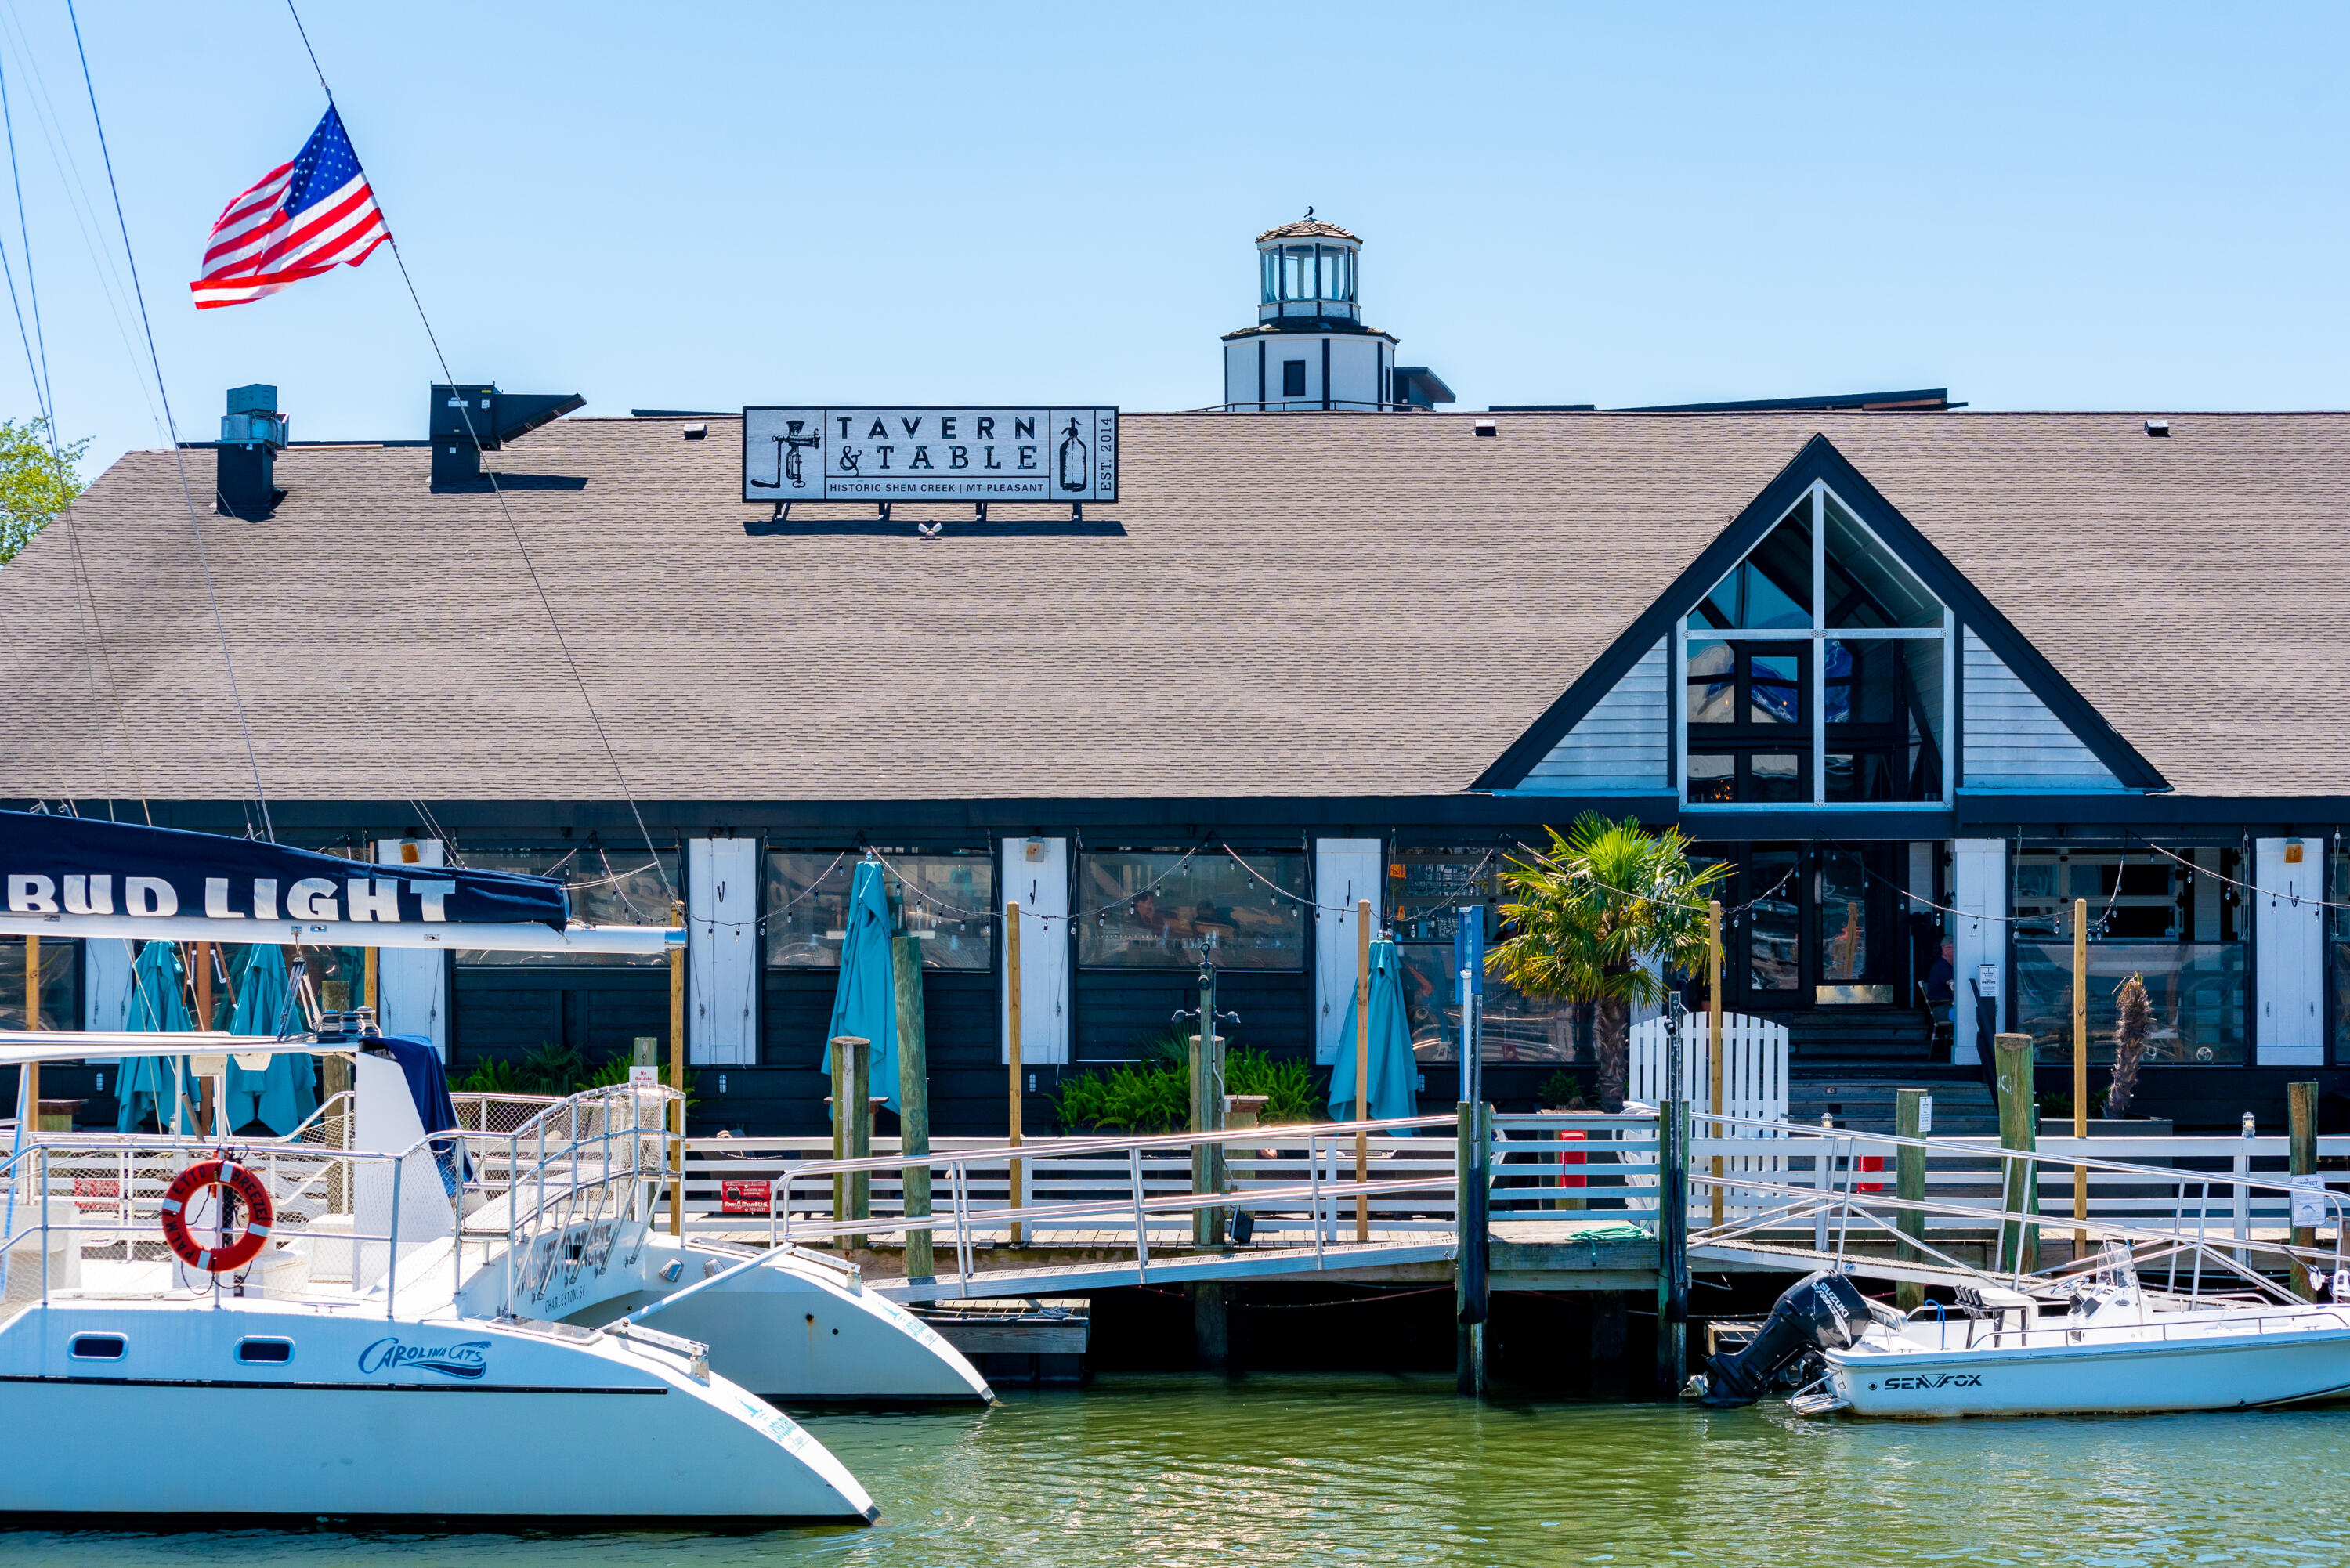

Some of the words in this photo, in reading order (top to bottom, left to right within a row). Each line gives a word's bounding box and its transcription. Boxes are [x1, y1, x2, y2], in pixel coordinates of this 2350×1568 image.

[837, 416, 1035, 439] TAVERN
[1100, 417, 1112, 452] 2014
[839, 445, 862, 476] &
[876, 445, 1037, 470] TABLE
[1100, 459, 1112, 492] EST.
[830, 483, 881, 493] HISTORIC
[885, 483, 916, 493] SHEM
[920, 483, 956, 493] CREEK
[966, 483, 983, 493] MT
[987, 483, 1044, 493] PLEASANT
[7, 874, 179, 917] BUD
[204, 877, 457, 923] LIGHT
[231, 1169, 269, 1221] BREEZE
[580, 1284, 586, 1301] SC
[1819, 1282, 1850, 1318] SUZUKI
[357, 1336, 447, 1375] CAROLINA
[448, 1340, 493, 1363] CATS
[1884, 1377, 1931, 1390] SEA
[1936, 1374, 1983, 1388] FOX
